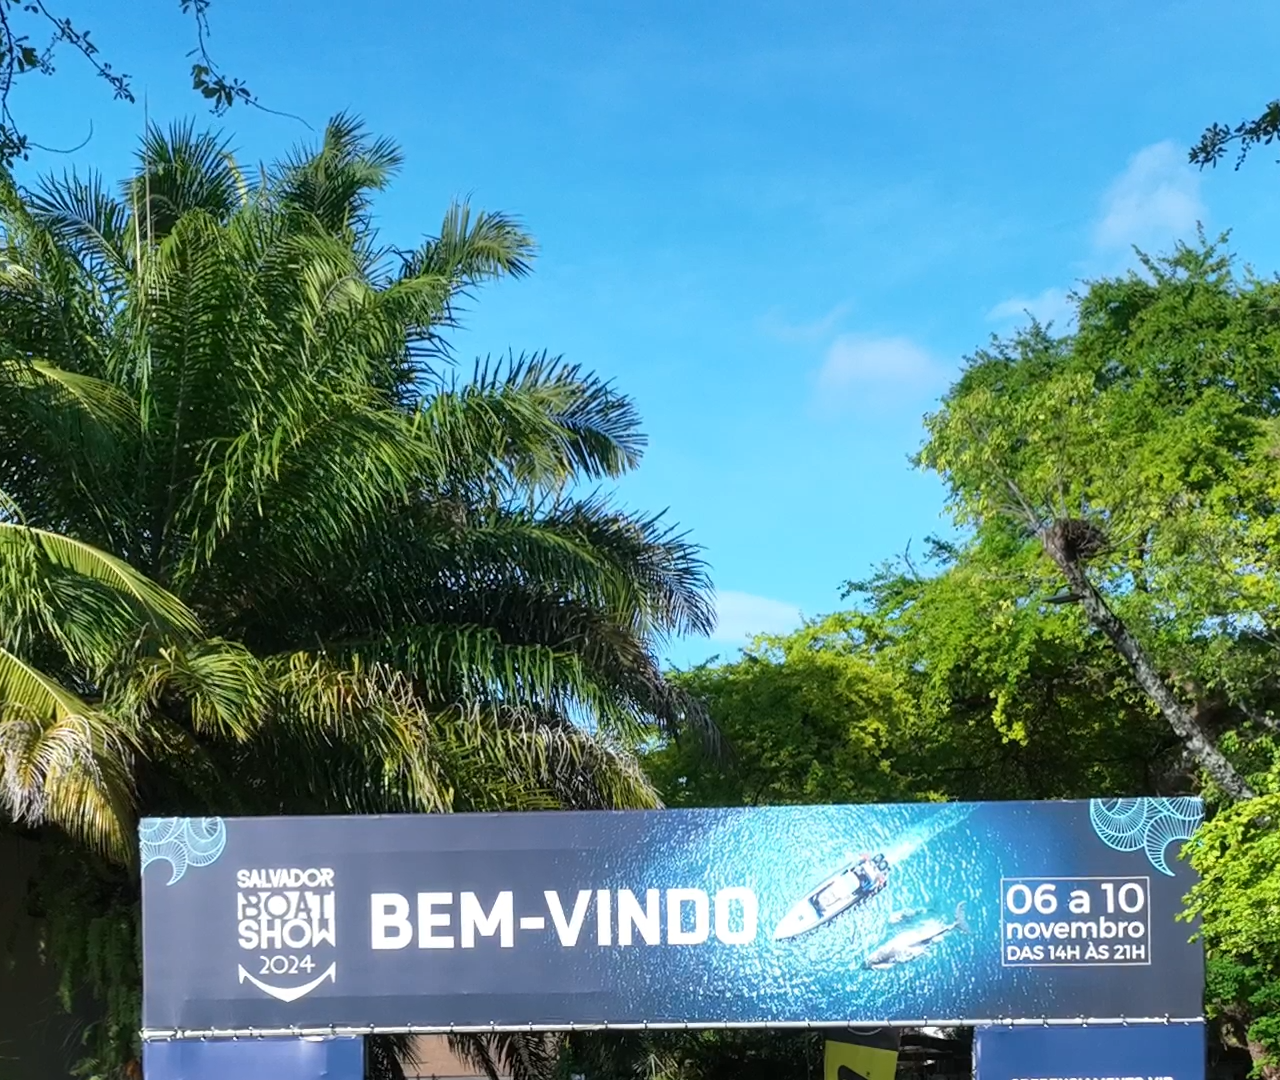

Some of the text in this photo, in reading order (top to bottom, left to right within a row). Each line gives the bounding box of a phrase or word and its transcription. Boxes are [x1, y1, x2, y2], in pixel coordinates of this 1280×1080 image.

[237, 868, 335, 888] SALVADOR
[238, 891, 336, 920] BOAT
[1006, 882, 1145, 915] 06 a 10
[370, 886, 757, 950] BEM-VINDO
[1006, 916, 1146, 939] novembro
[238, 919, 336, 949] SHOW
[1007, 941, 1146, 961] DAS 14H ÀS 21H
[259, 955, 316, 975] 2024
